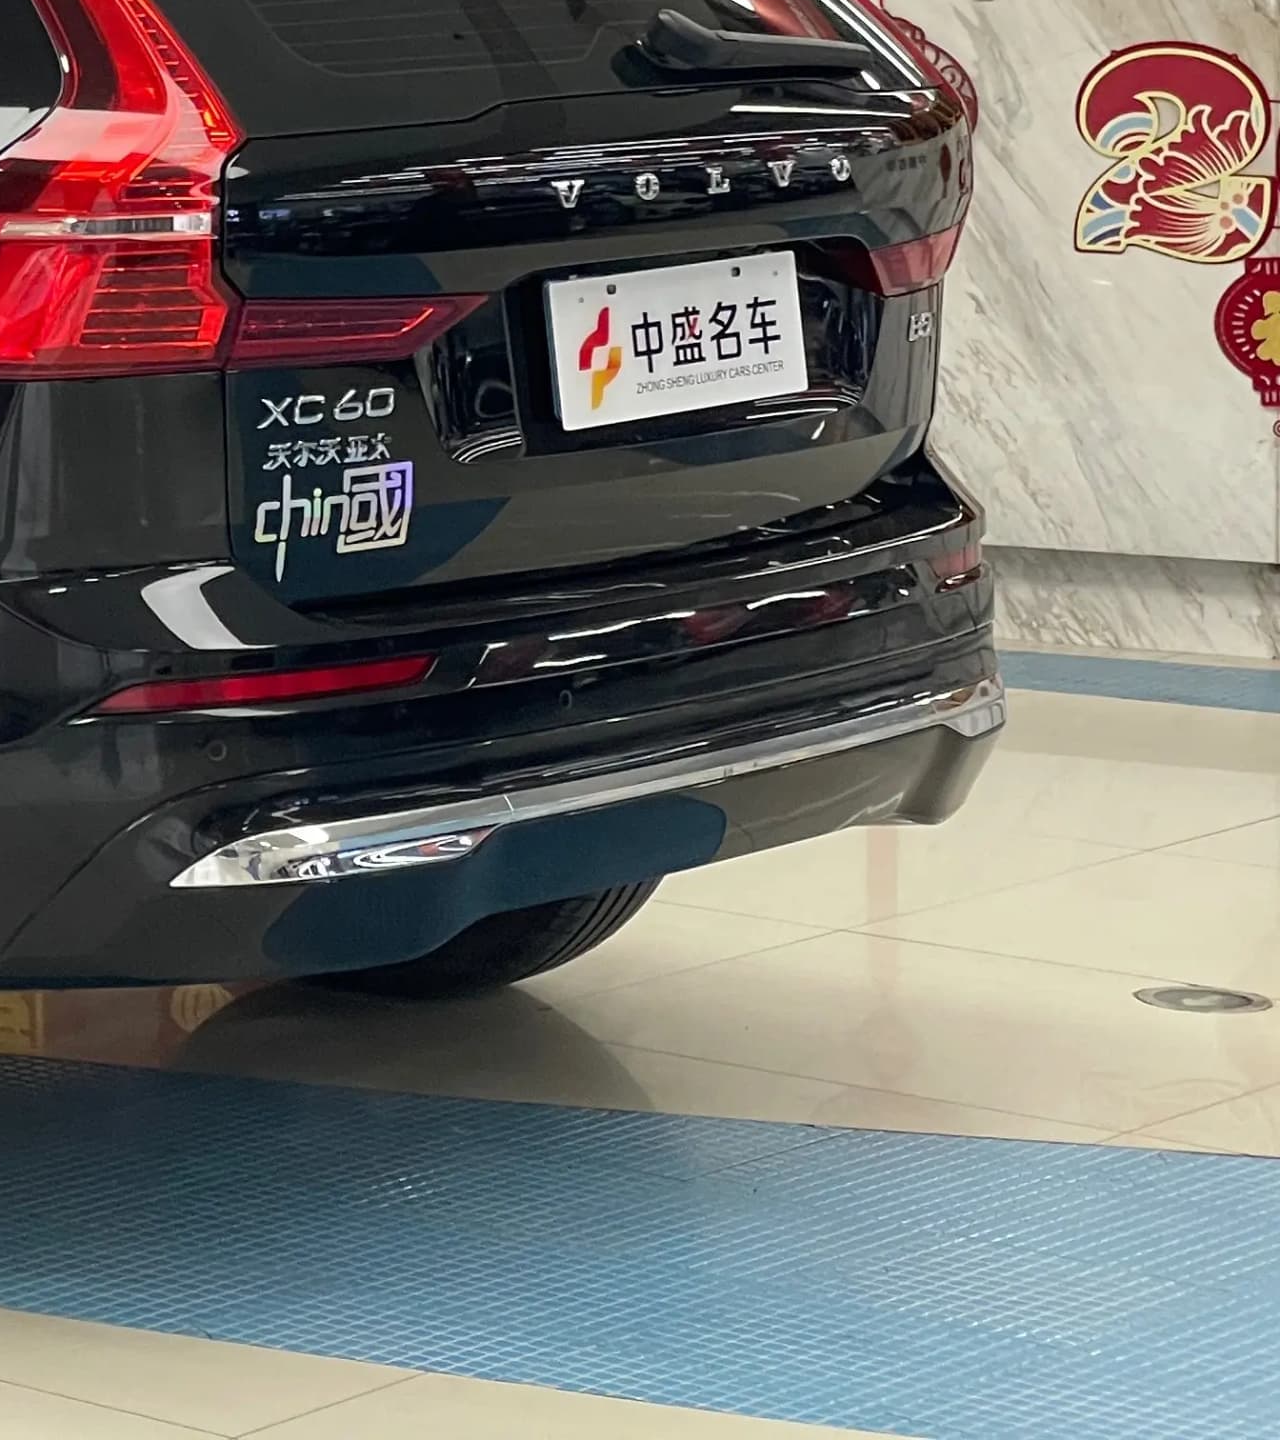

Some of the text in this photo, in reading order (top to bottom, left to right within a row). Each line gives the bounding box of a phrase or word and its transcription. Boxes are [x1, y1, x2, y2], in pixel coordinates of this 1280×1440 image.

[551, 155, 852, 209] VOLVO
[631, 296, 781, 373] 中盛名车
[636, 360, 784, 394] ZHONG SHENG LUXURY CARS CENTER
[262, 433, 392, 470] 沃尔沃亚太
